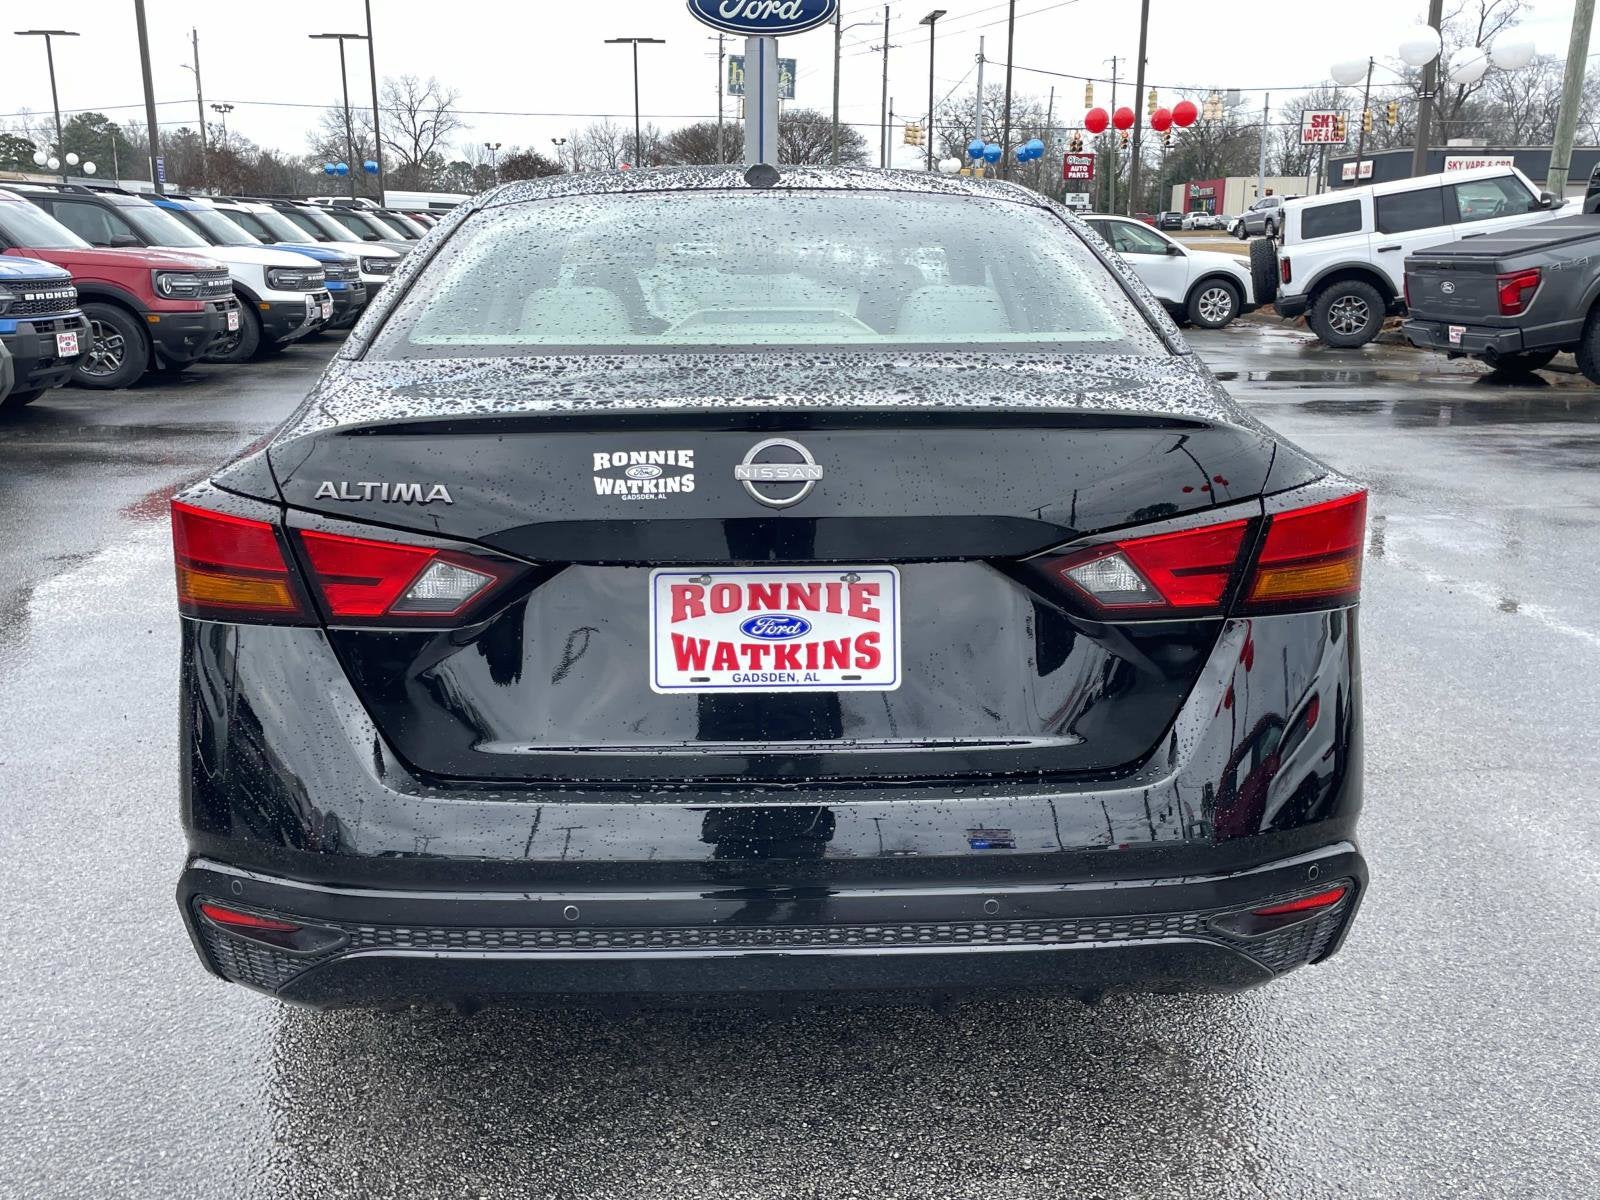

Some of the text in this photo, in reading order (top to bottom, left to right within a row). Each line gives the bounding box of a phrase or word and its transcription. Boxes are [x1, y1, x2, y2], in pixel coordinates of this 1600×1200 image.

[719, 0, 803, 20] Ford
[1303, 129, 1323, 141] VAPE
[1324, 129, 1329, 141] &
[1447, 161, 1464, 170] SKY
[25, 291, 75, 300] BRONCO
[593, 450, 694, 471] RONNIE
[737, 468, 821, 478] NISSAN
[314, 481, 454, 505] ALTIMA
[593, 474, 695, 495] WATKINS
[671, 582, 881, 623] RONNIE
[752, 617, 801, 635] Ford
[671, 631, 881, 671] WATKINS
[732, 671, 820, 683] GADSDEN, AL
